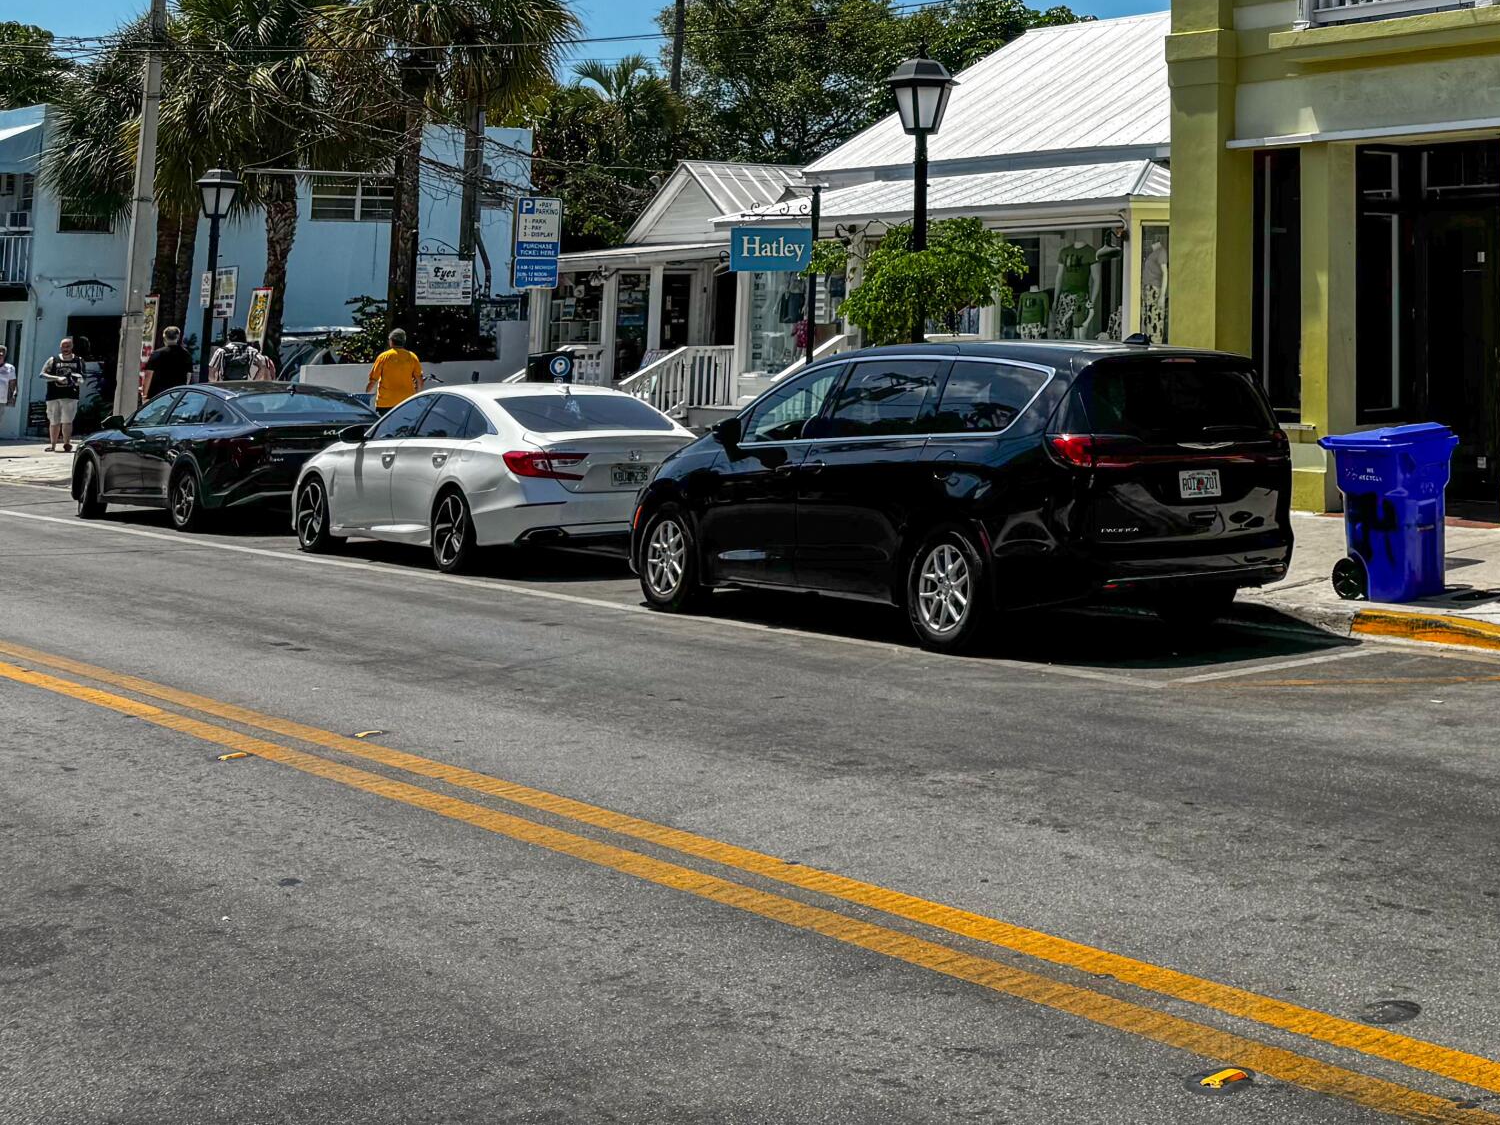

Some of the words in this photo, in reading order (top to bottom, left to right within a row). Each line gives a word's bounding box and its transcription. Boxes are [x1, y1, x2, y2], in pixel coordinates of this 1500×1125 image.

[522, 200, 533, 214] P
[741, 236, 805, 262] Hatley
[433, 266, 457, 281] Eyes
[66, 285, 104, 299] BLACKFIN
